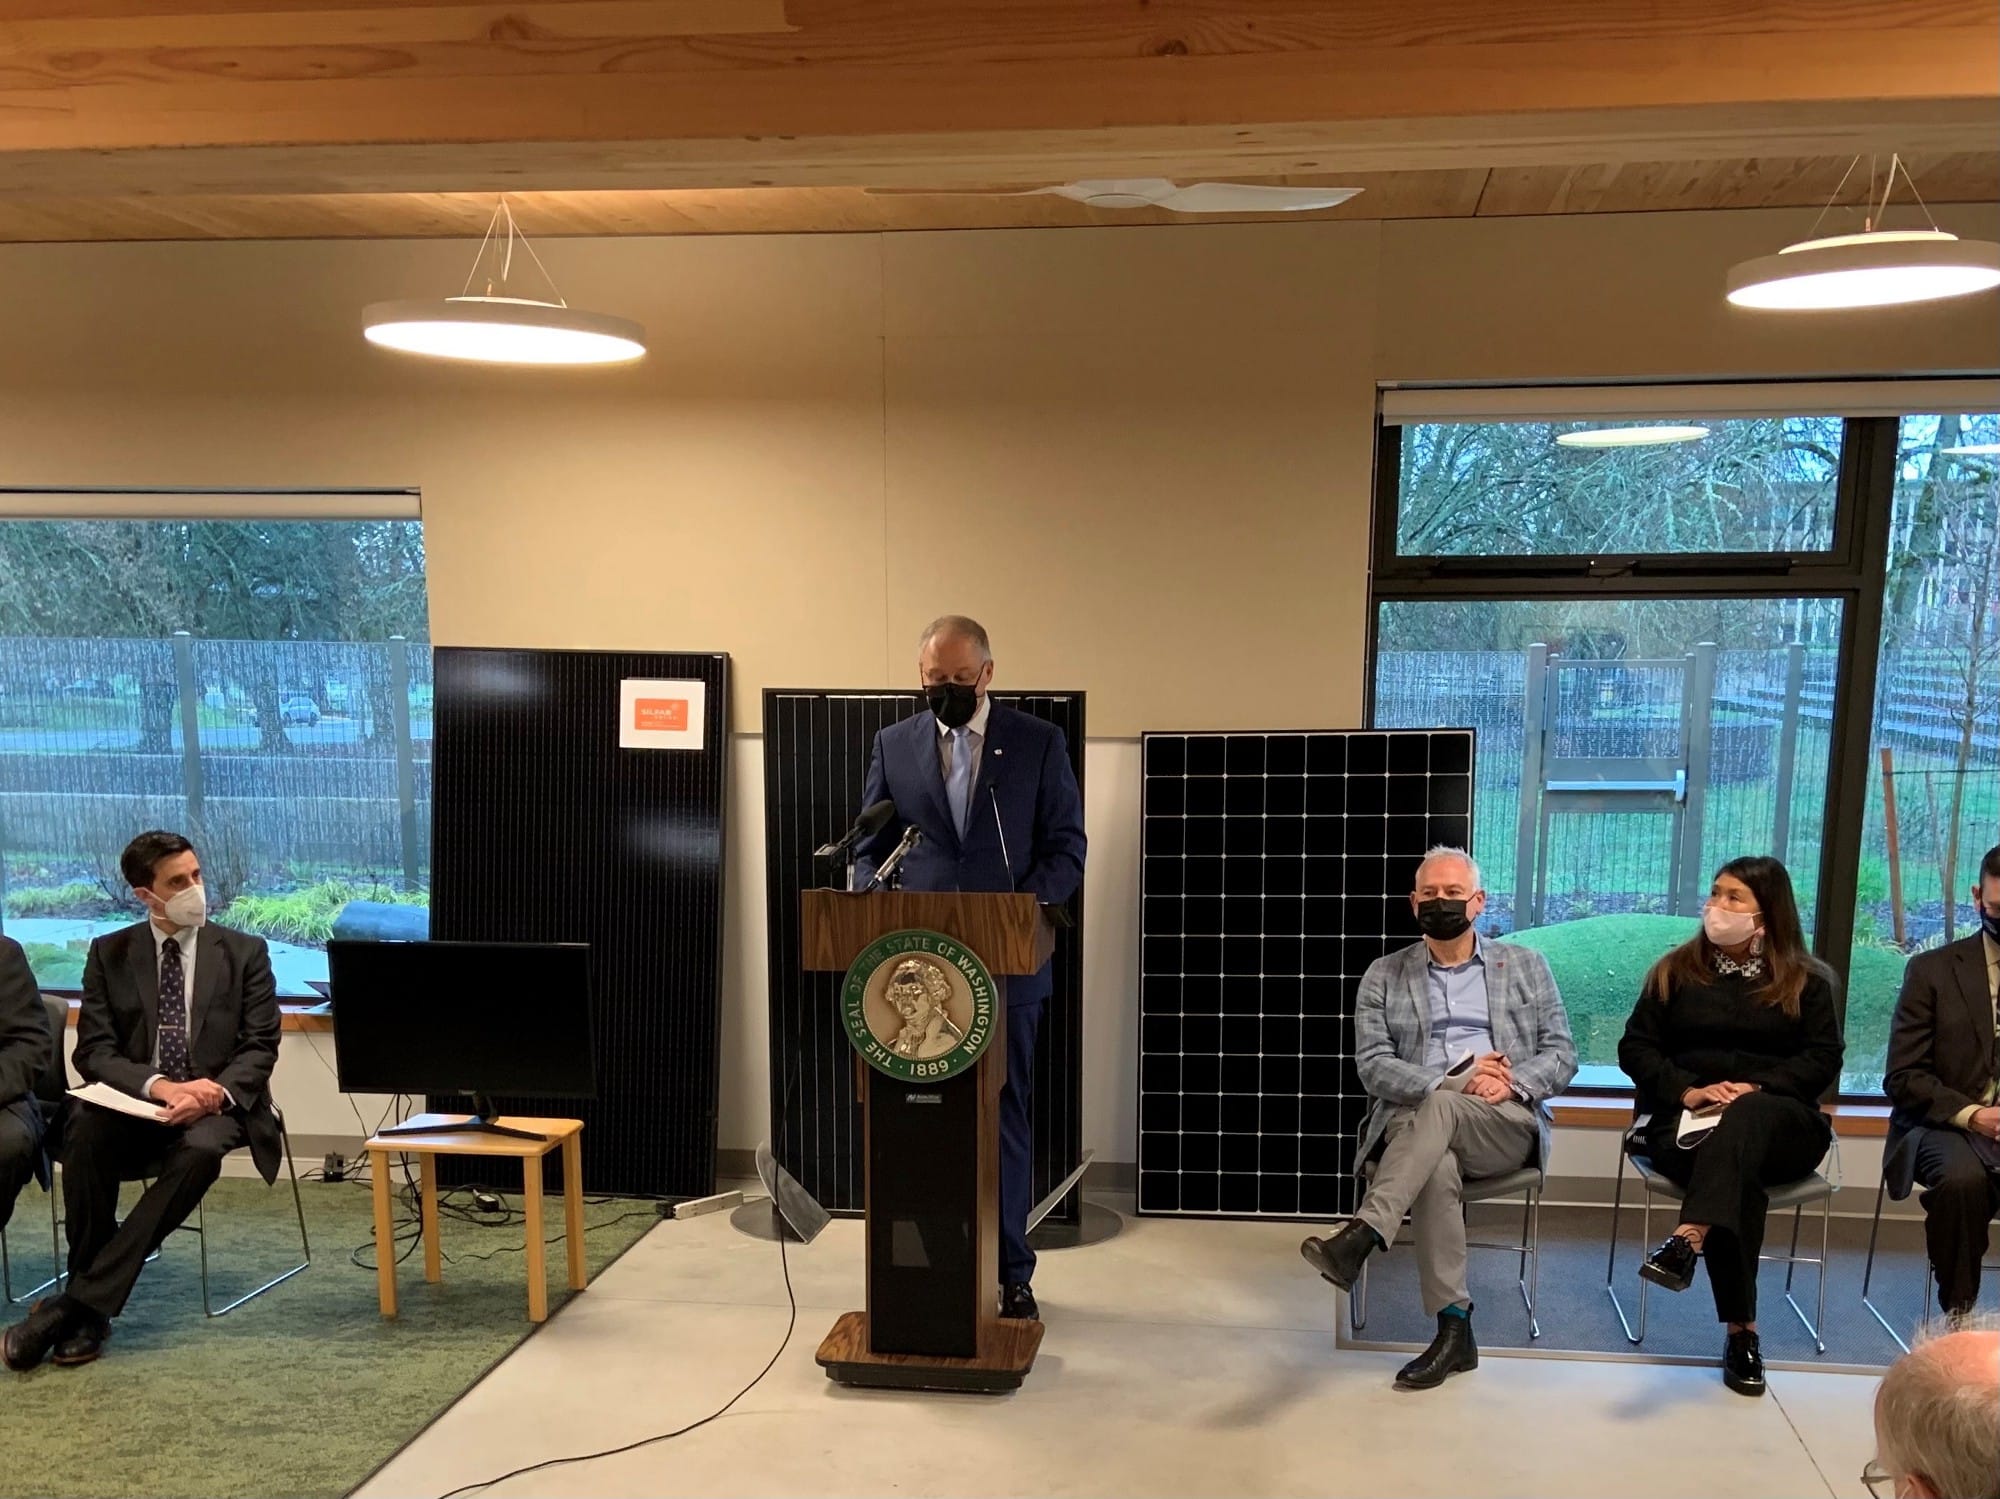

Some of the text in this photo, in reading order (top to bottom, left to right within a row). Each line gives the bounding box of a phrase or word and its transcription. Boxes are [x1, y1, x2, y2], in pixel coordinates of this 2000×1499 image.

[847, 937, 990, 1068] THE SEAL OF THE STATE OF WASHINGTON
[909, 1060, 949, 1077] 1889
